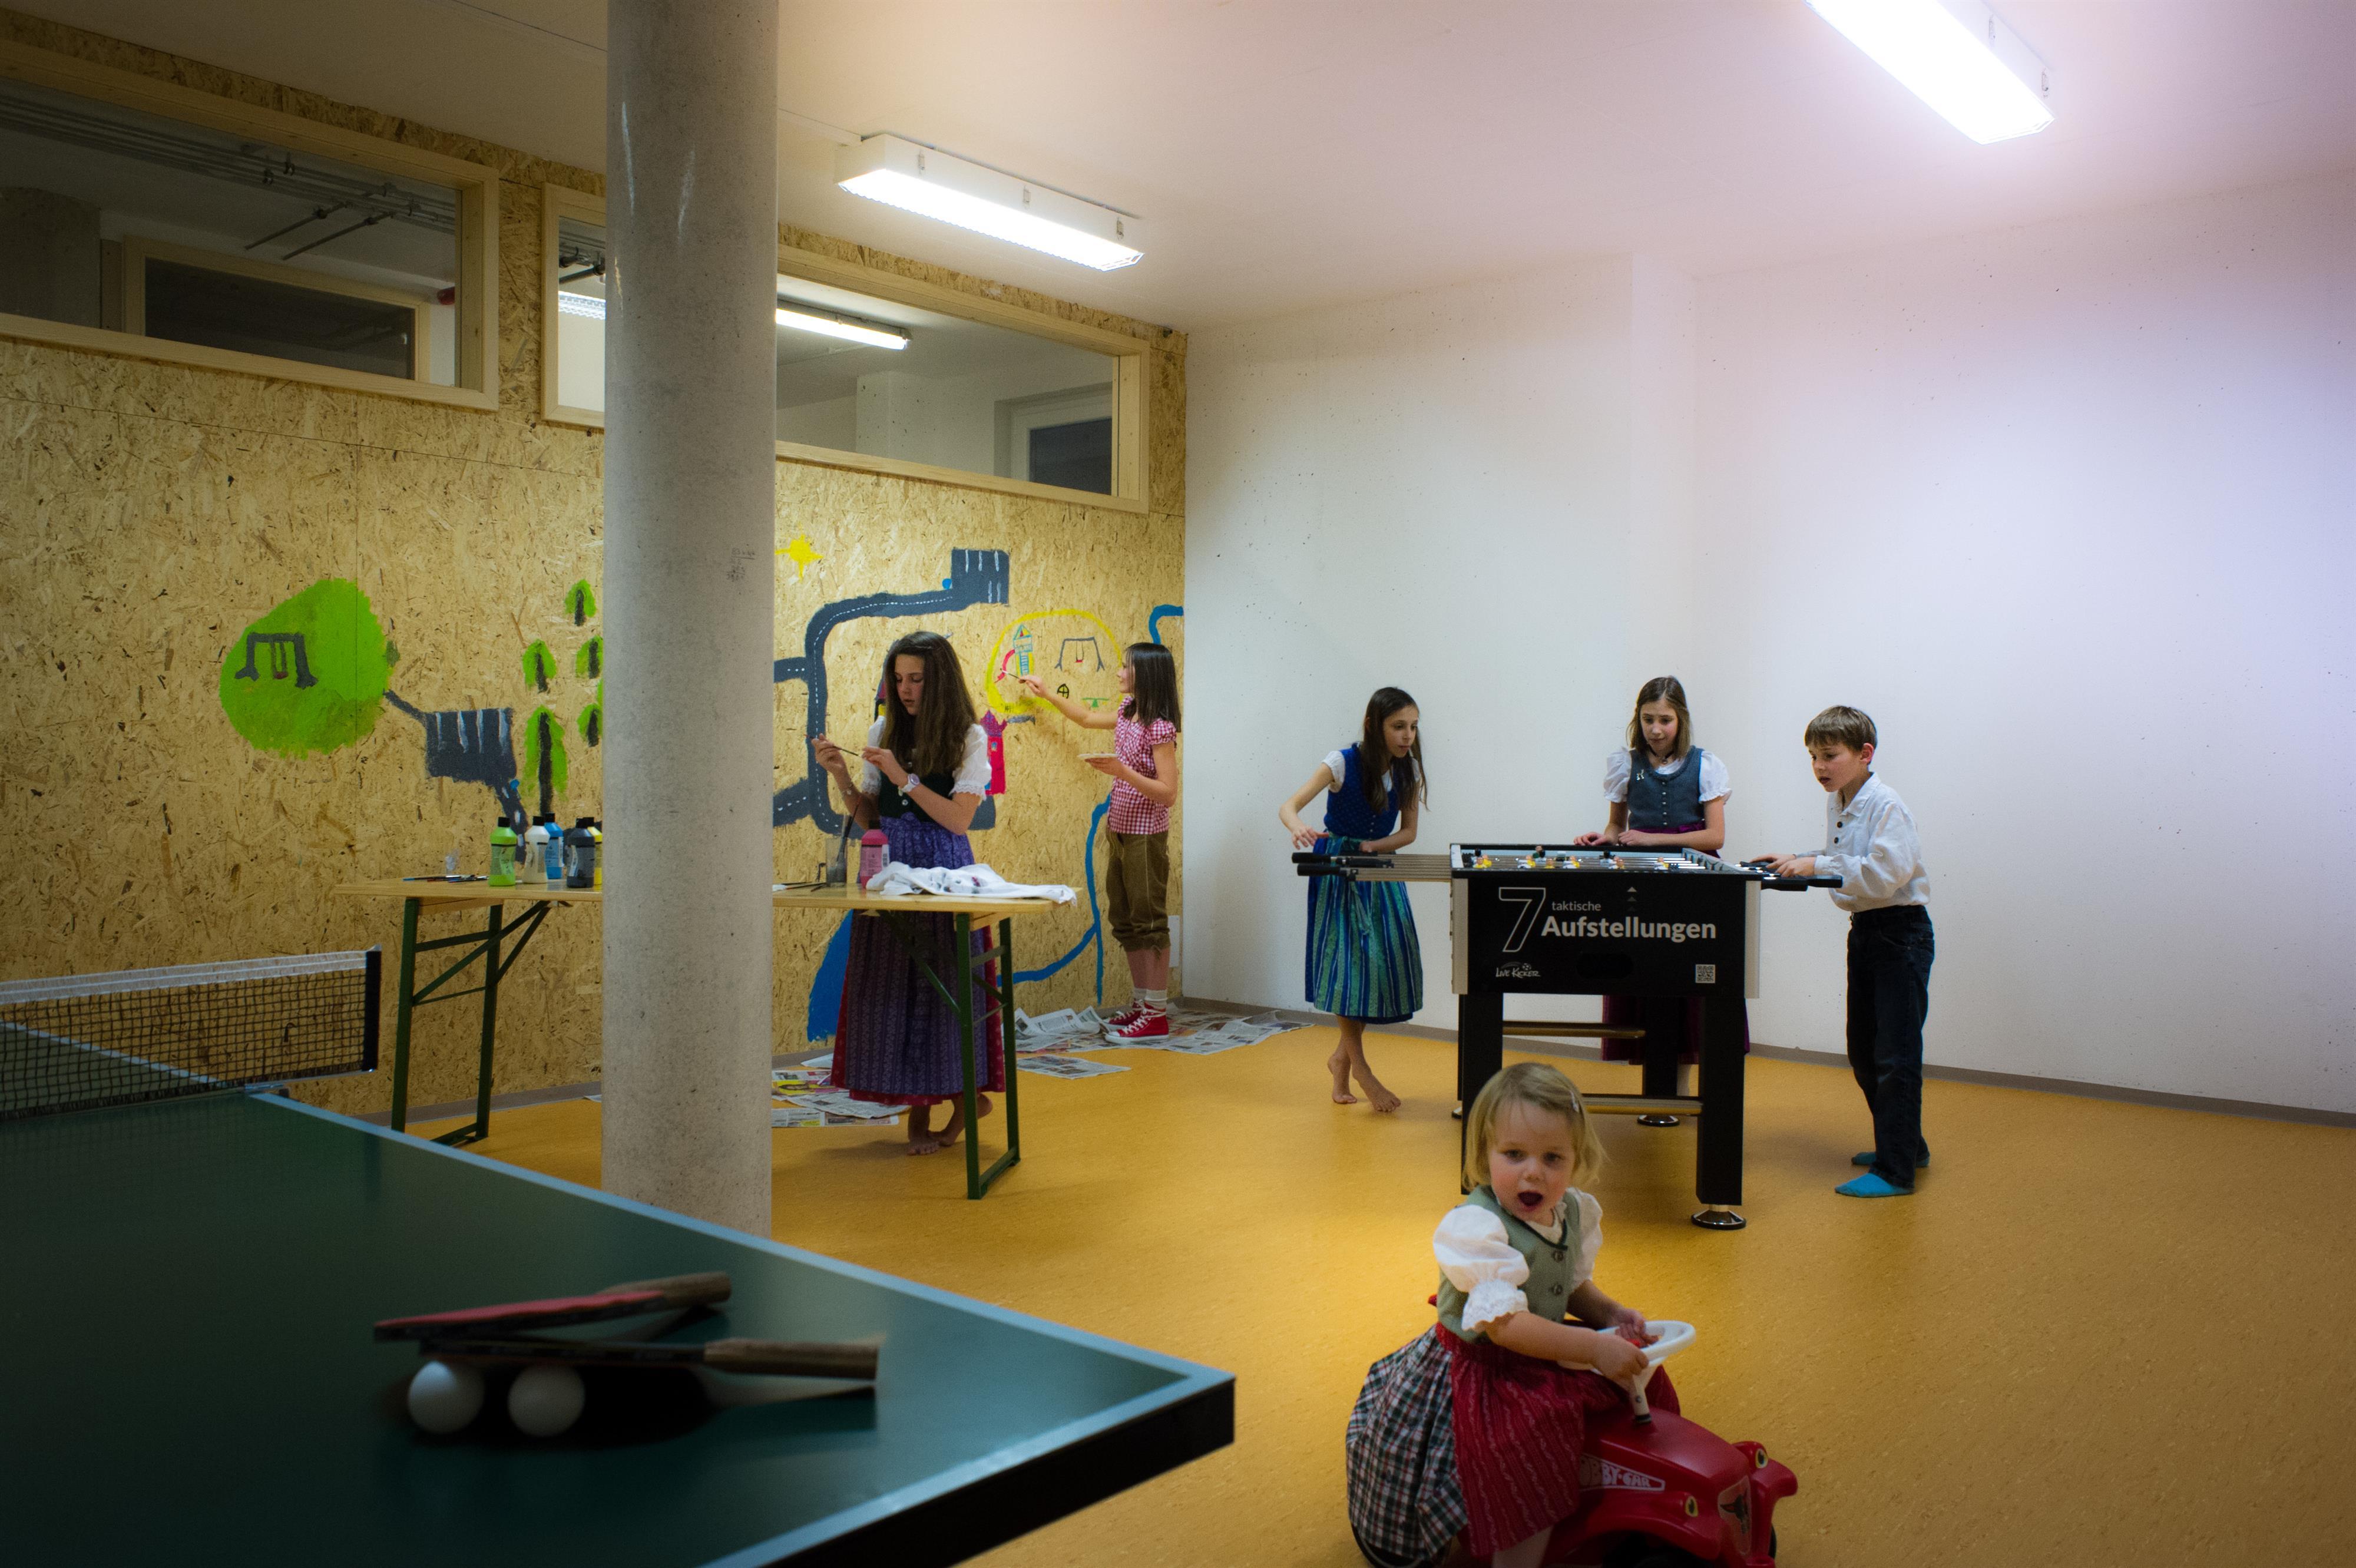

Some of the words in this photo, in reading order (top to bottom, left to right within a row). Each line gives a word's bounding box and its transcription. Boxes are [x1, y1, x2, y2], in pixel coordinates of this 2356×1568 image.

[1498, 886, 1546, 952] 7
[1551, 900, 1601, 912] taktische
[1541, 916, 1716, 943] Aufstellungen
